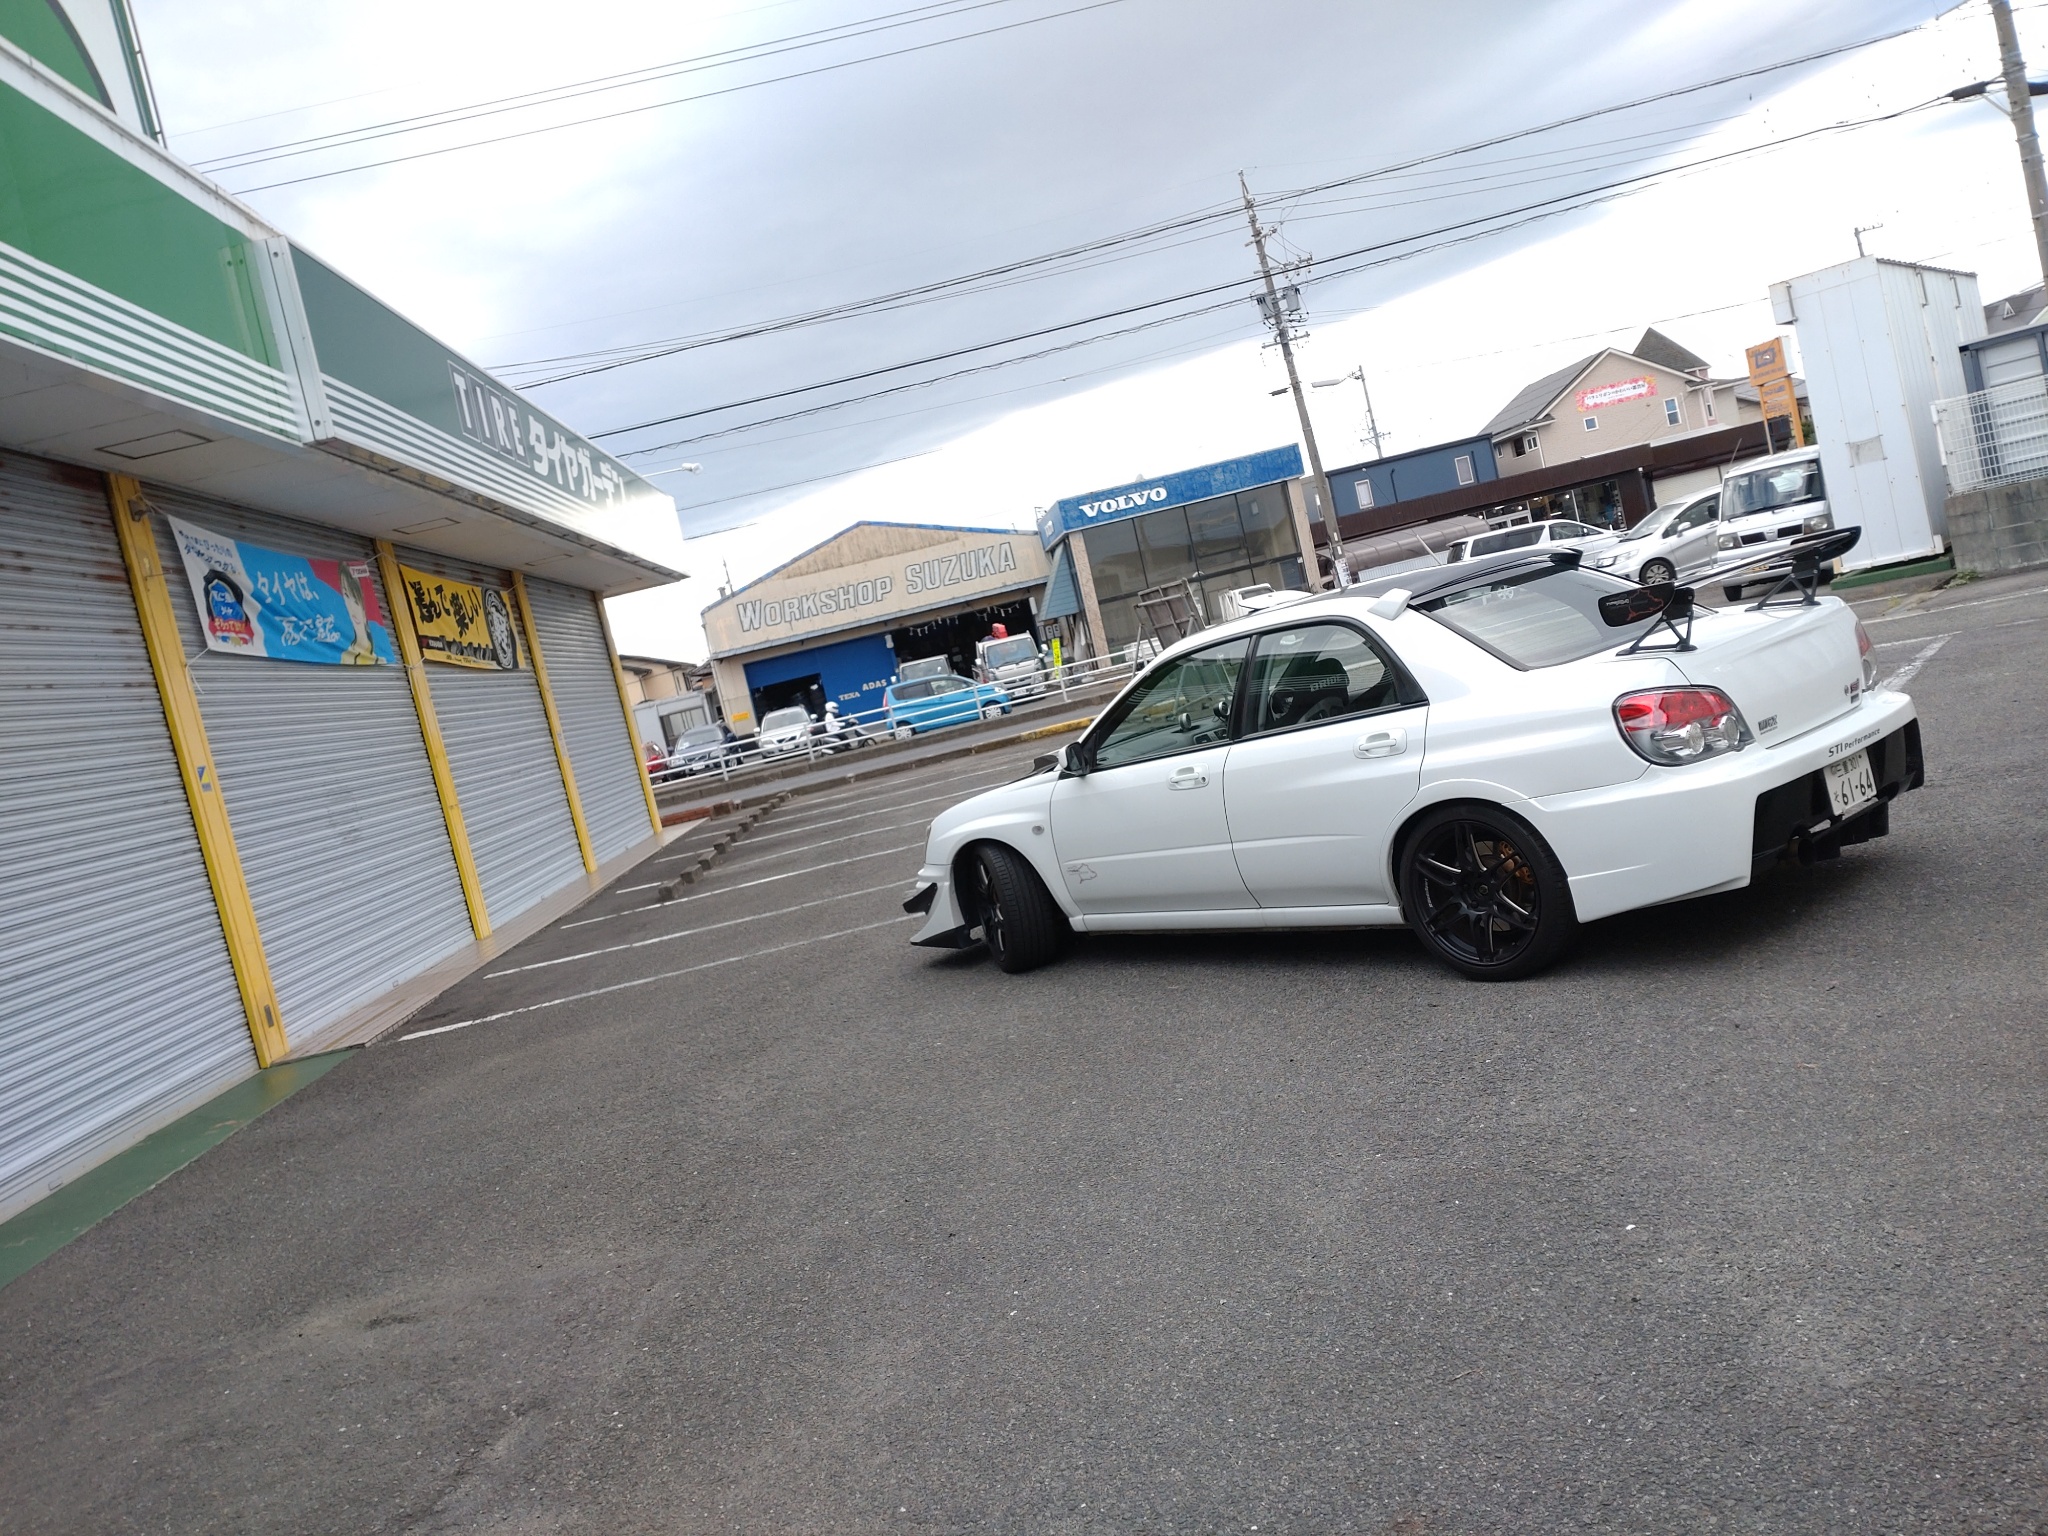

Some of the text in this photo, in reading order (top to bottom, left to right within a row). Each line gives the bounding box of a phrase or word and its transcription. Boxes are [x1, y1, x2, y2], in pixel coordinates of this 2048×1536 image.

[453, 371, 525, 457] TIRE
[1079, 487, 1168, 518] VOLVO
[736, 541, 1017, 632] WORKSHOP SUZUKA
[862, 679, 888, 692] ADAS
[1828, 728, 1881, 758] STI Performance
